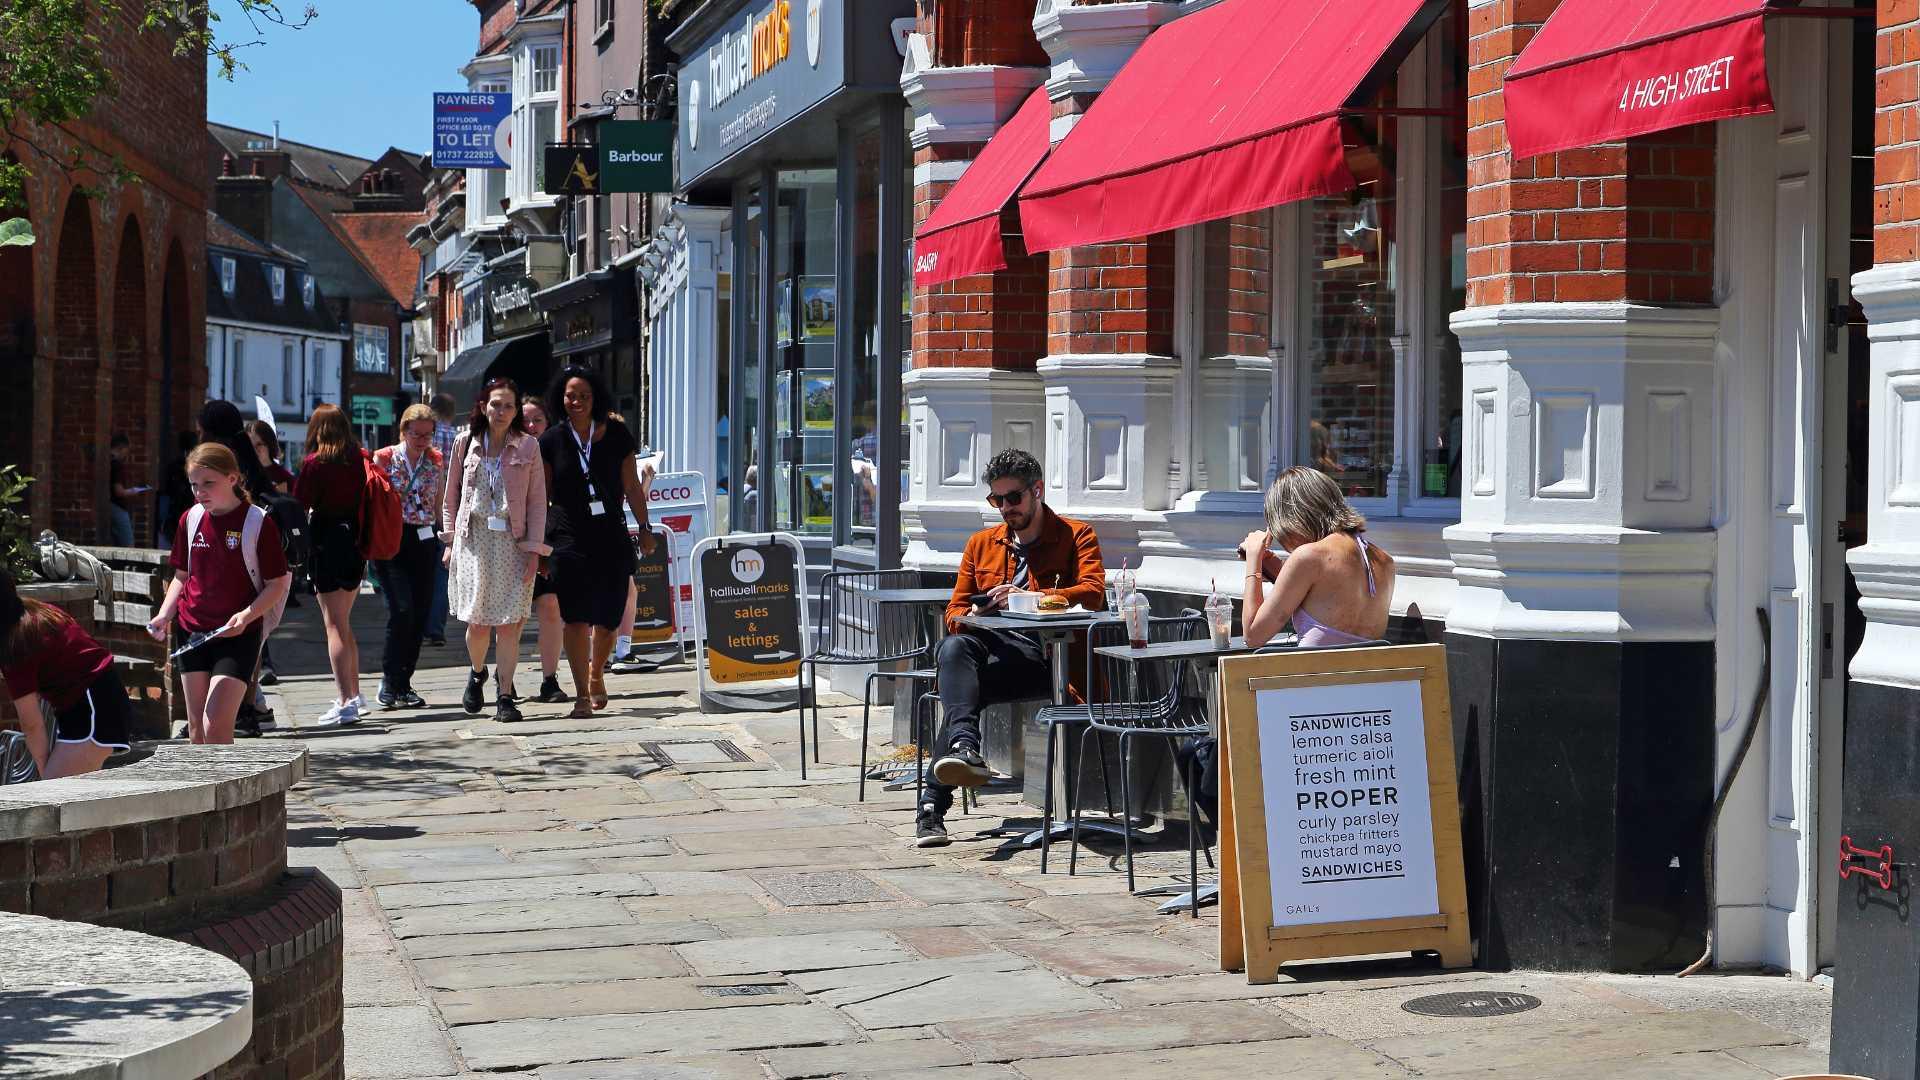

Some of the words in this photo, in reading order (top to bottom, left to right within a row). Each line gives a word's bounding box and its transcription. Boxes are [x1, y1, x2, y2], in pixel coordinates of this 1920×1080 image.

[709, 0, 790, 109] halliwellmarks
[1619, 81, 1630, 112] 4
[1631, 71, 1679, 110] HIGH
[1680, 55, 1734, 100] STREET
[437, 95, 495, 105] RAYNERS
[437, 133, 458, 146] TO
[463, 133, 492, 146] LET
[436, 150, 462, 159] 01737
[608, 150, 663, 162] Barbour
[647, 486, 690, 502] ecco
[735, 552, 761, 573] hm
[710, 583, 790, 598] halliwellmarks
[734, 605, 769, 619] sales
[748, 622, 758, 632] &
[728, 633, 779, 648] lettings
[1290, 714, 1391, 732] SANDWICHES
[1292, 734, 1344, 749] lemon
[1350, 730, 1392, 745] salsa
[1293, 749, 1357, 765] turmeric
[1363, 746, 1394, 760] aioli
[1294, 766, 1345, 786] fresh
[1353, 764, 1397, 782] mint
[1296, 786, 1398, 811] PROPER
[1298, 813, 1336, 831] curly
[1343, 811, 1399, 829] parsley
[1299, 832, 1355, 845] chickpea
[1358, 829, 1400, 841] fritters
[1301, 843, 1358, 859] mustard
[1364, 843, 1402, 857] mayo
[1302, 860, 1403, 878] SANDWICHES
